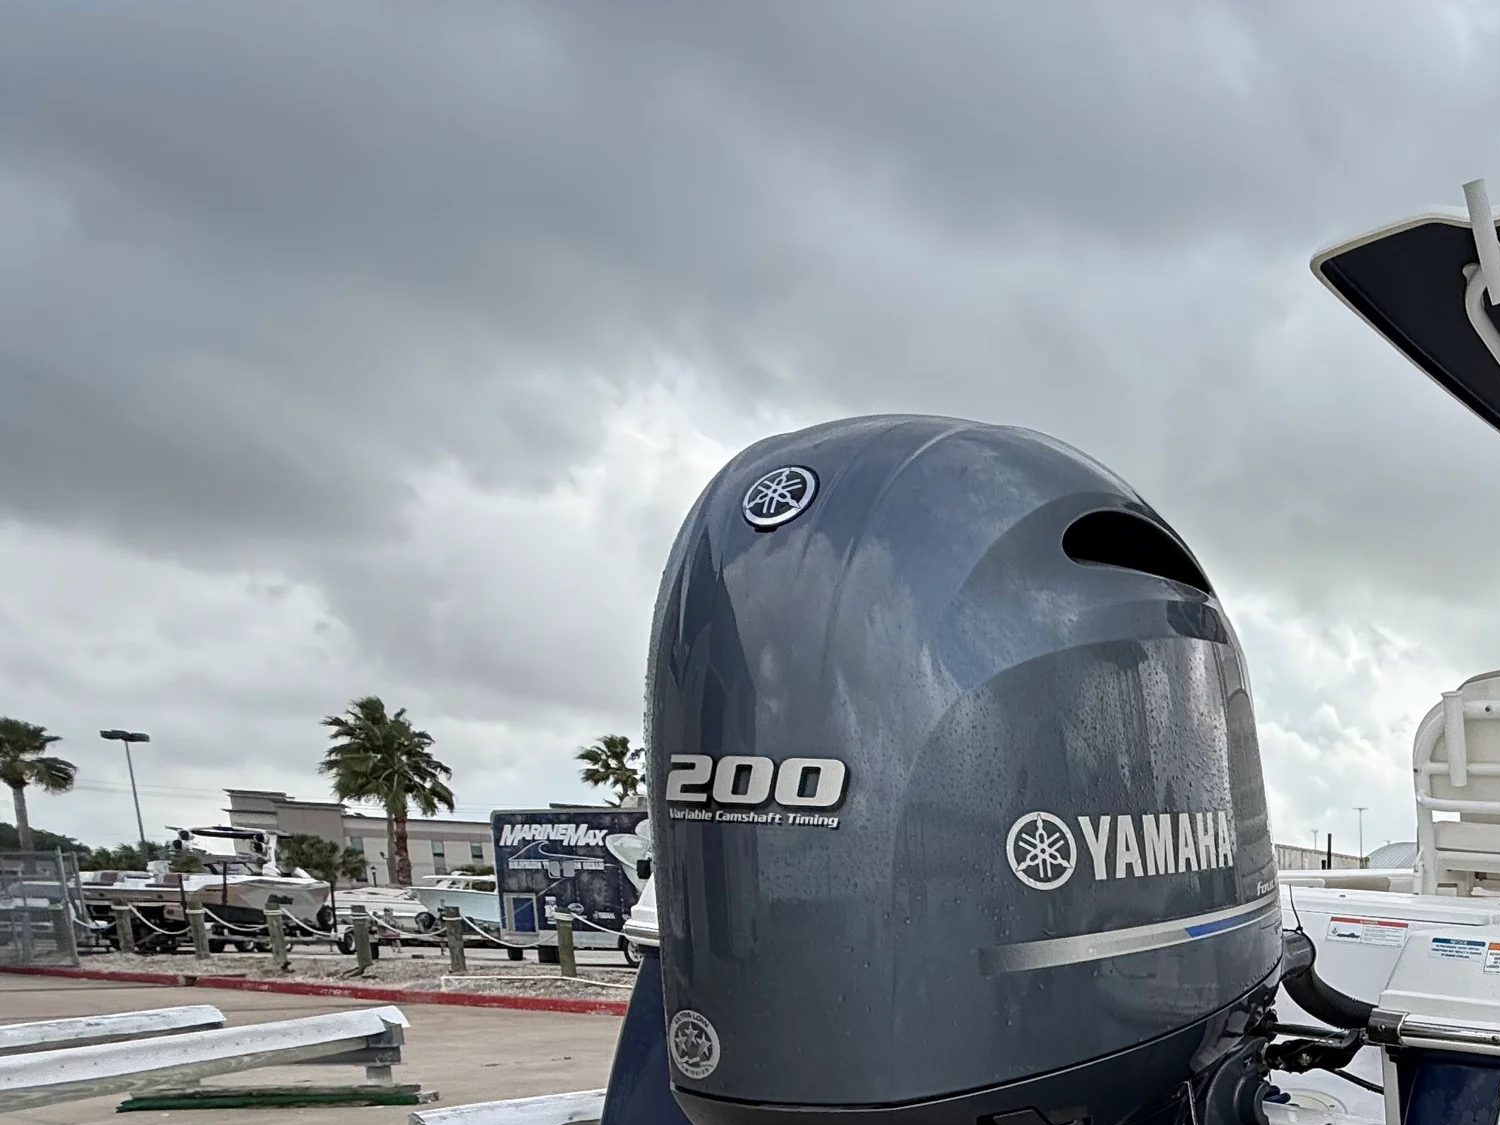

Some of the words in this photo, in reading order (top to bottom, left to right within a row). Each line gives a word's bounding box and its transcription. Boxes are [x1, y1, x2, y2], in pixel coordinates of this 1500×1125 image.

[666, 754, 847, 808] 200
[669, 808, 712, 820] Variable
[715, 810, 782, 824] Camshaft
[787, 813, 839, 828] Timing
[1077, 811, 1236, 881] YAMAHA
